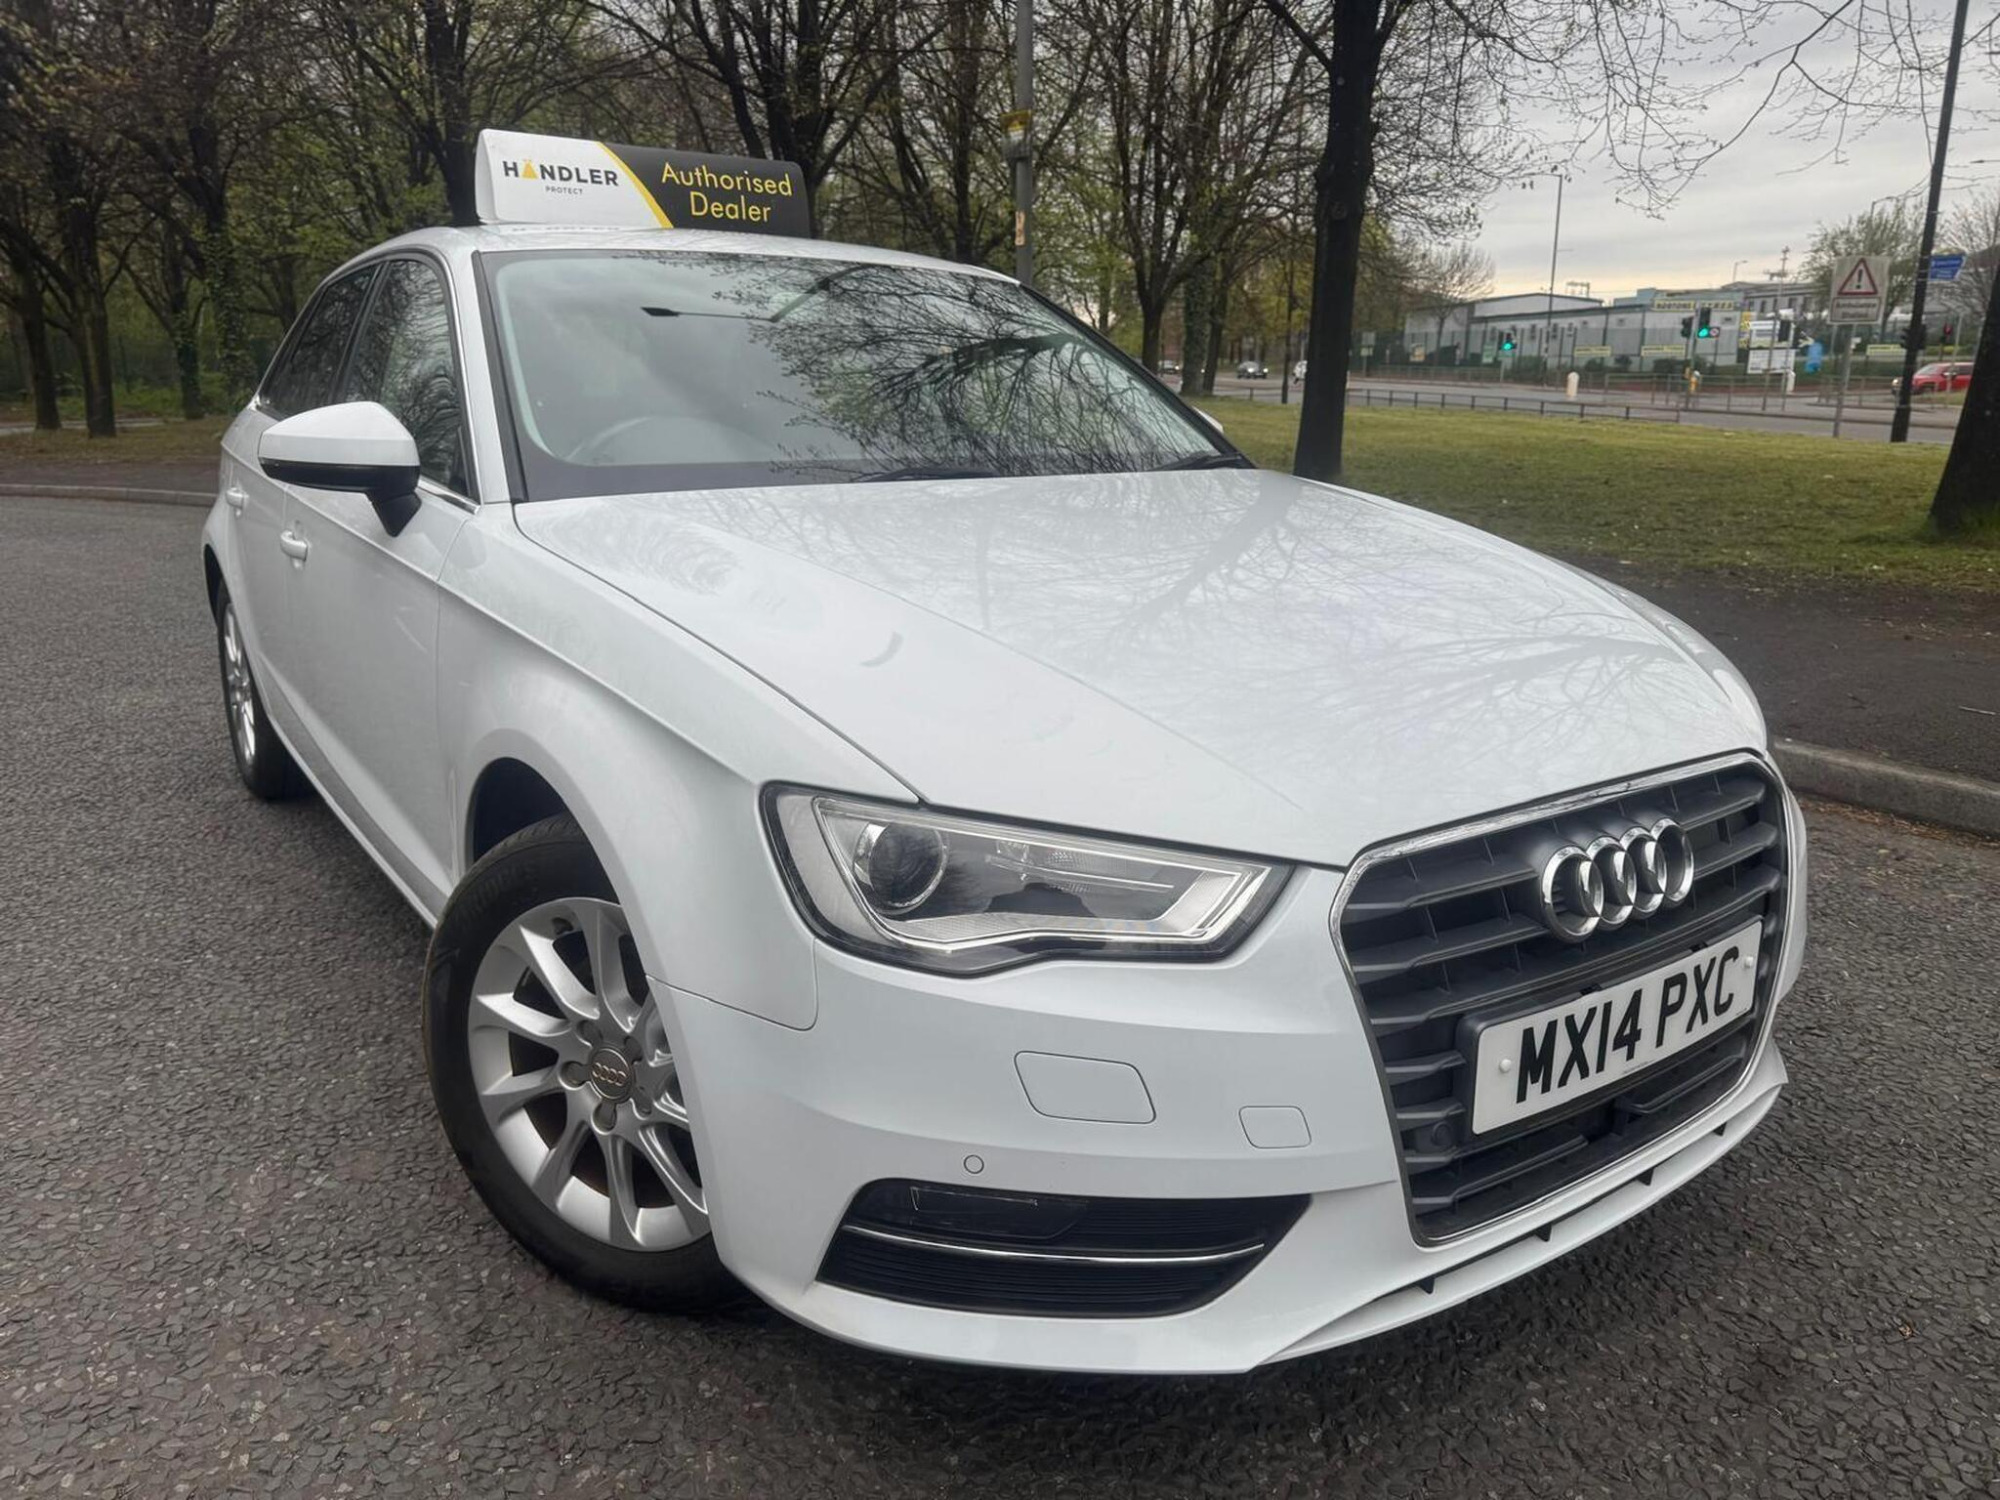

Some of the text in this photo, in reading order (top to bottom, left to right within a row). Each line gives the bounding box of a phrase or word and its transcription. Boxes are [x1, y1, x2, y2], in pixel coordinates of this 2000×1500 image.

[545, 185, 583, 195] PROTECT
[661, 162, 793, 197] Authorised
[690, 191, 772, 222] Dealer
[1516, 946, 1739, 1104] MX14 PXC
